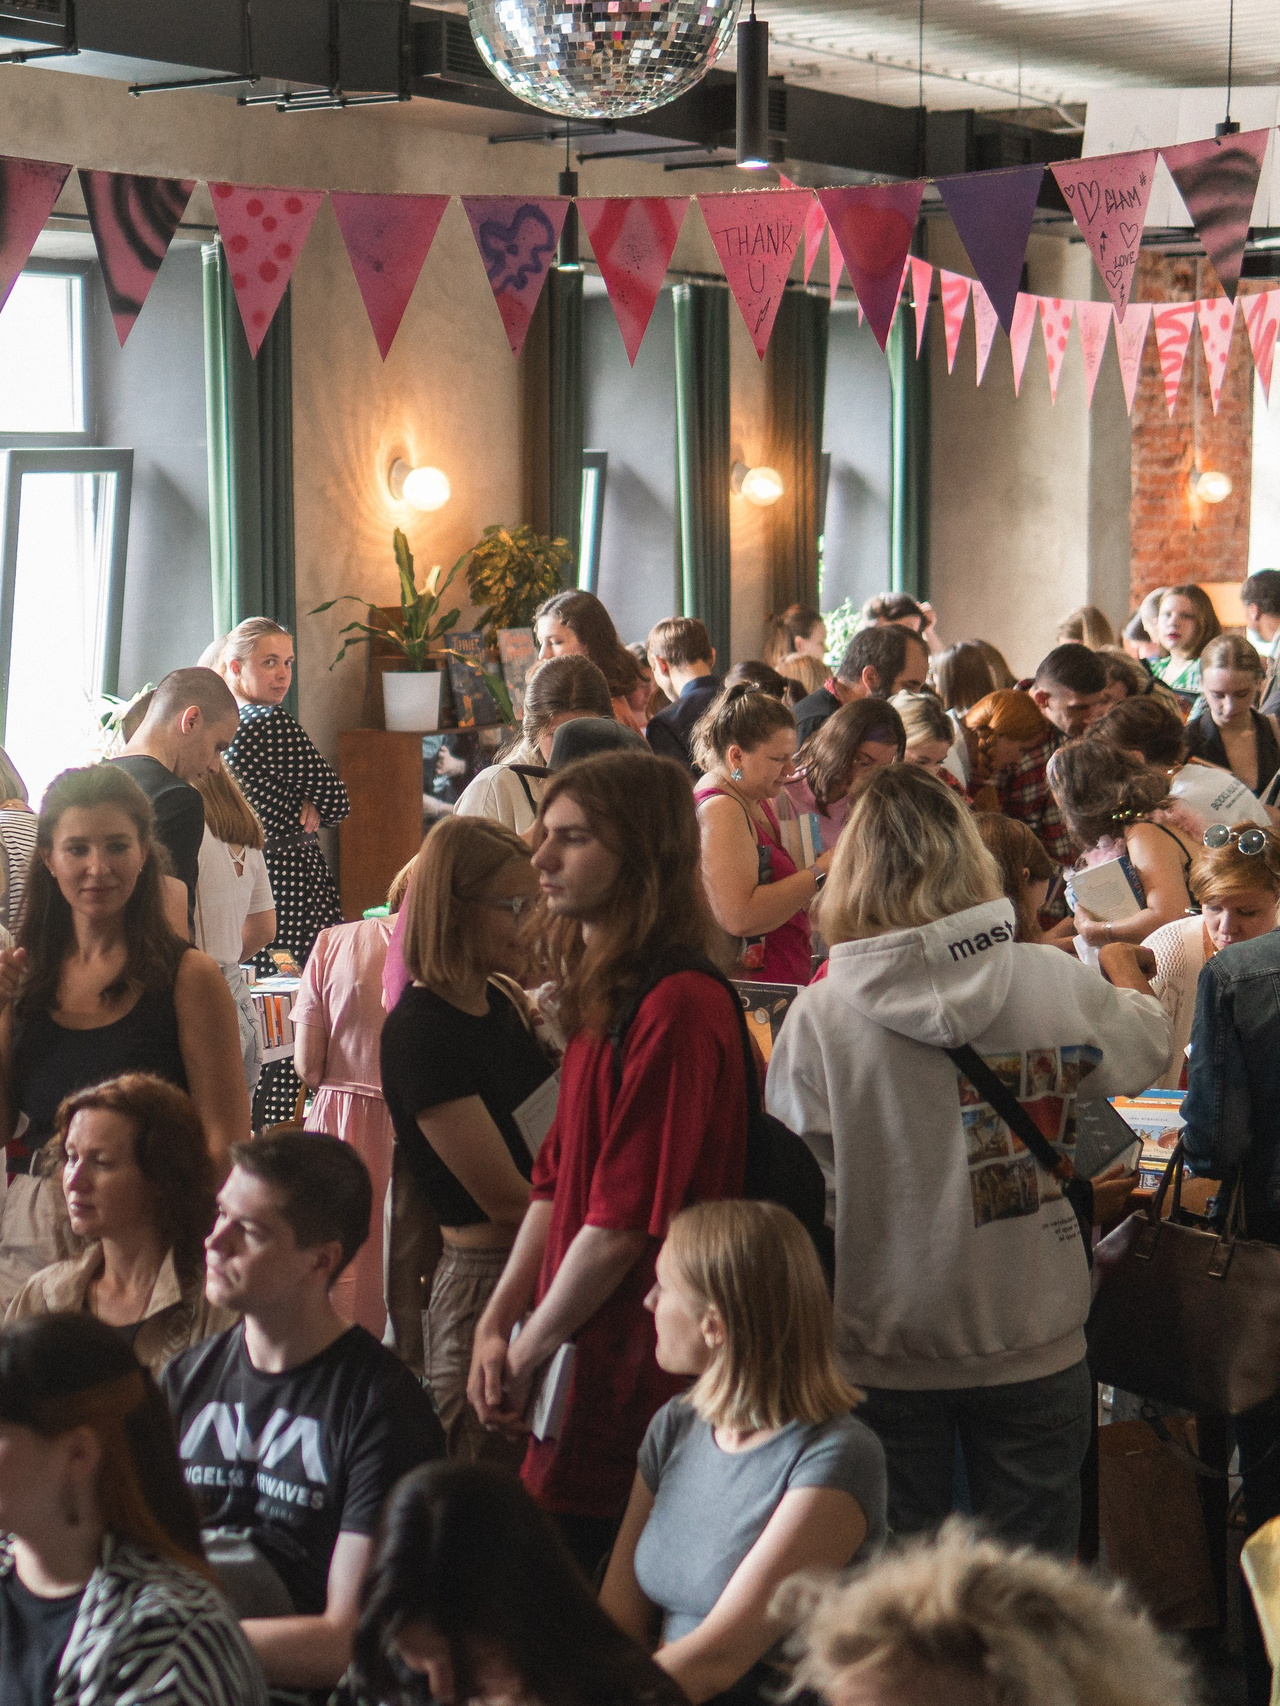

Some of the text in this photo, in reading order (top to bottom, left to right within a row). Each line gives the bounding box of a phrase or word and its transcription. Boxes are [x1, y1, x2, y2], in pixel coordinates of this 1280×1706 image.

[715, 222, 793, 256] THANK
[1113, 251, 1137, 269] LOVE
[747, 263, 765, 293] U
